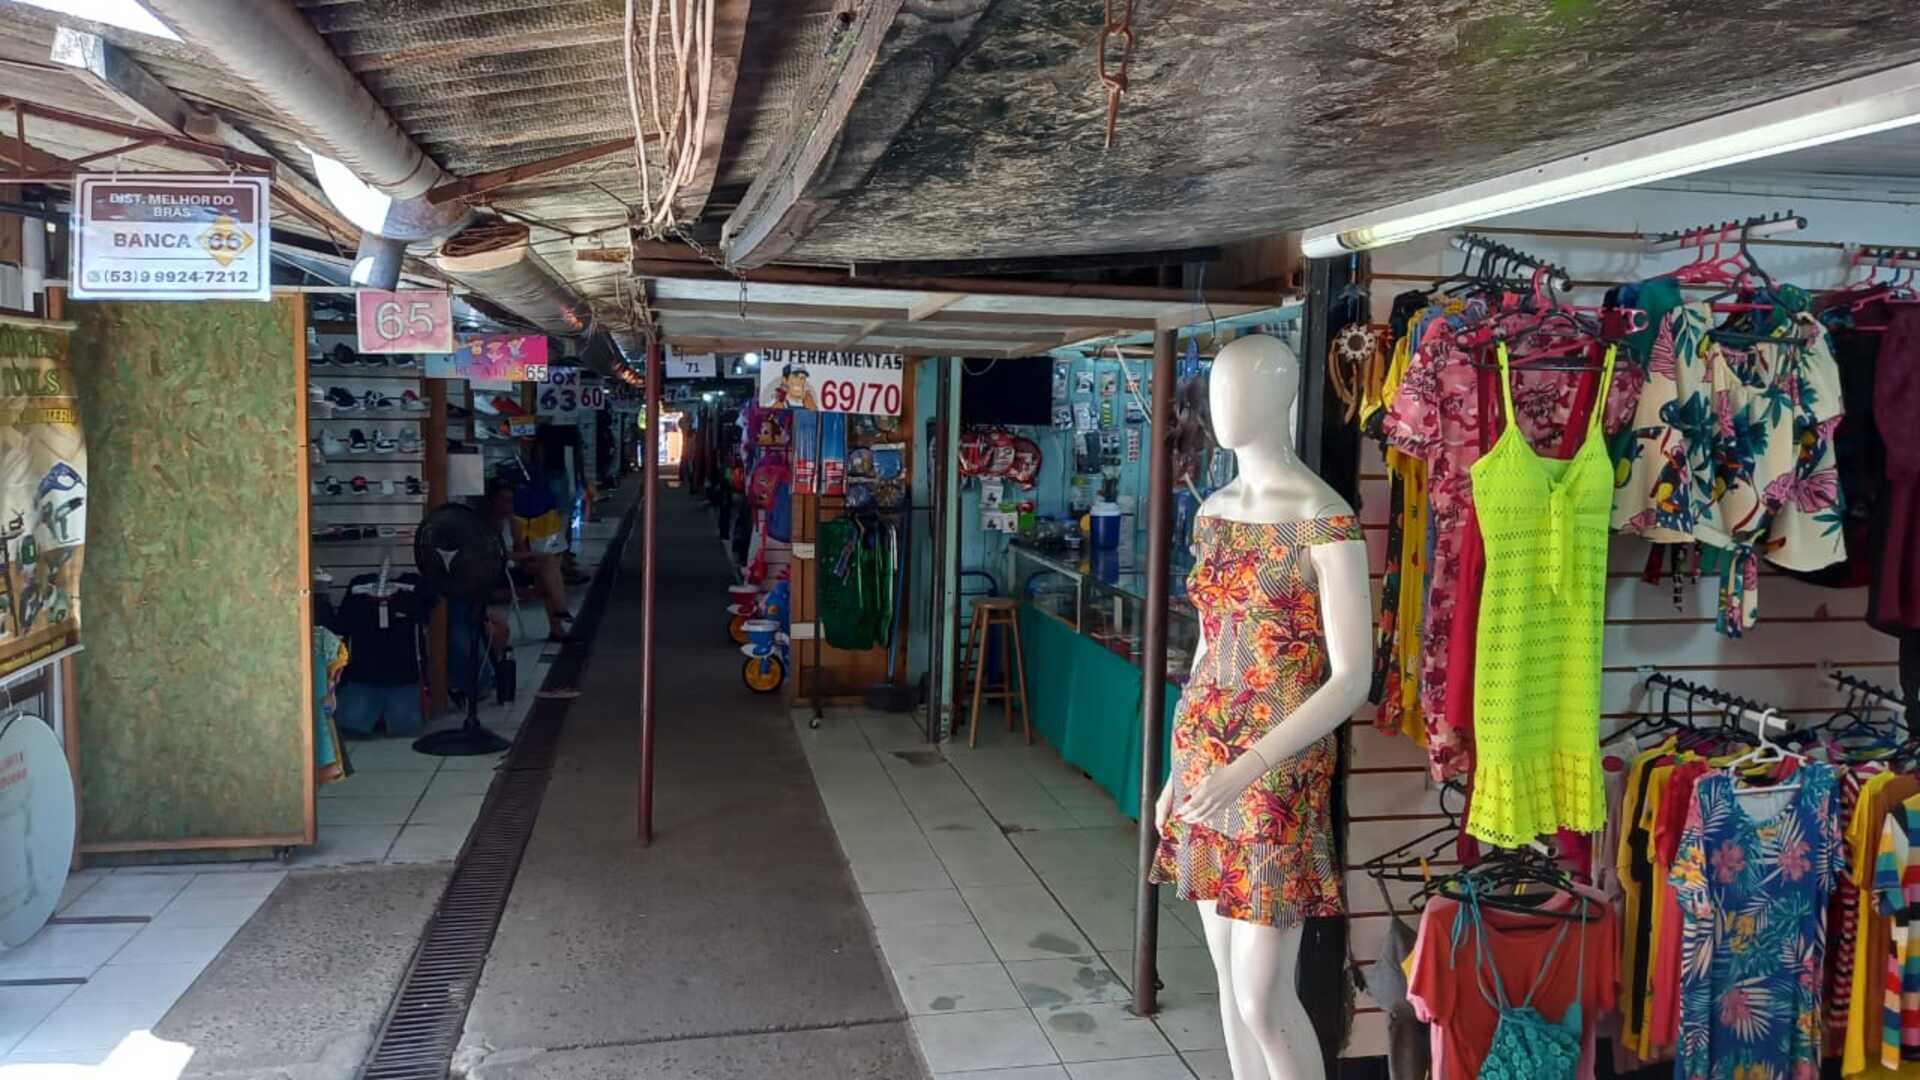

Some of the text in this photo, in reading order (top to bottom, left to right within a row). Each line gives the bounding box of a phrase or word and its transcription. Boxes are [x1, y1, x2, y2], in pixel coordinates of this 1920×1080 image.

[148, 194, 211, 206] MELHOR
[213, 195, 235, 206] DO
[113, 232, 192, 249] BANCA
[375, 301, 434, 341] 65
[685, 362, 700, 373] 71
[789, 350, 903, 370] FERRAMENTAS
[526, 364, 547, 382] 65
[540, 389, 577, 411] 63
[580, 387, 602, 408] 60
[820, 379, 901, 415] 69/70
